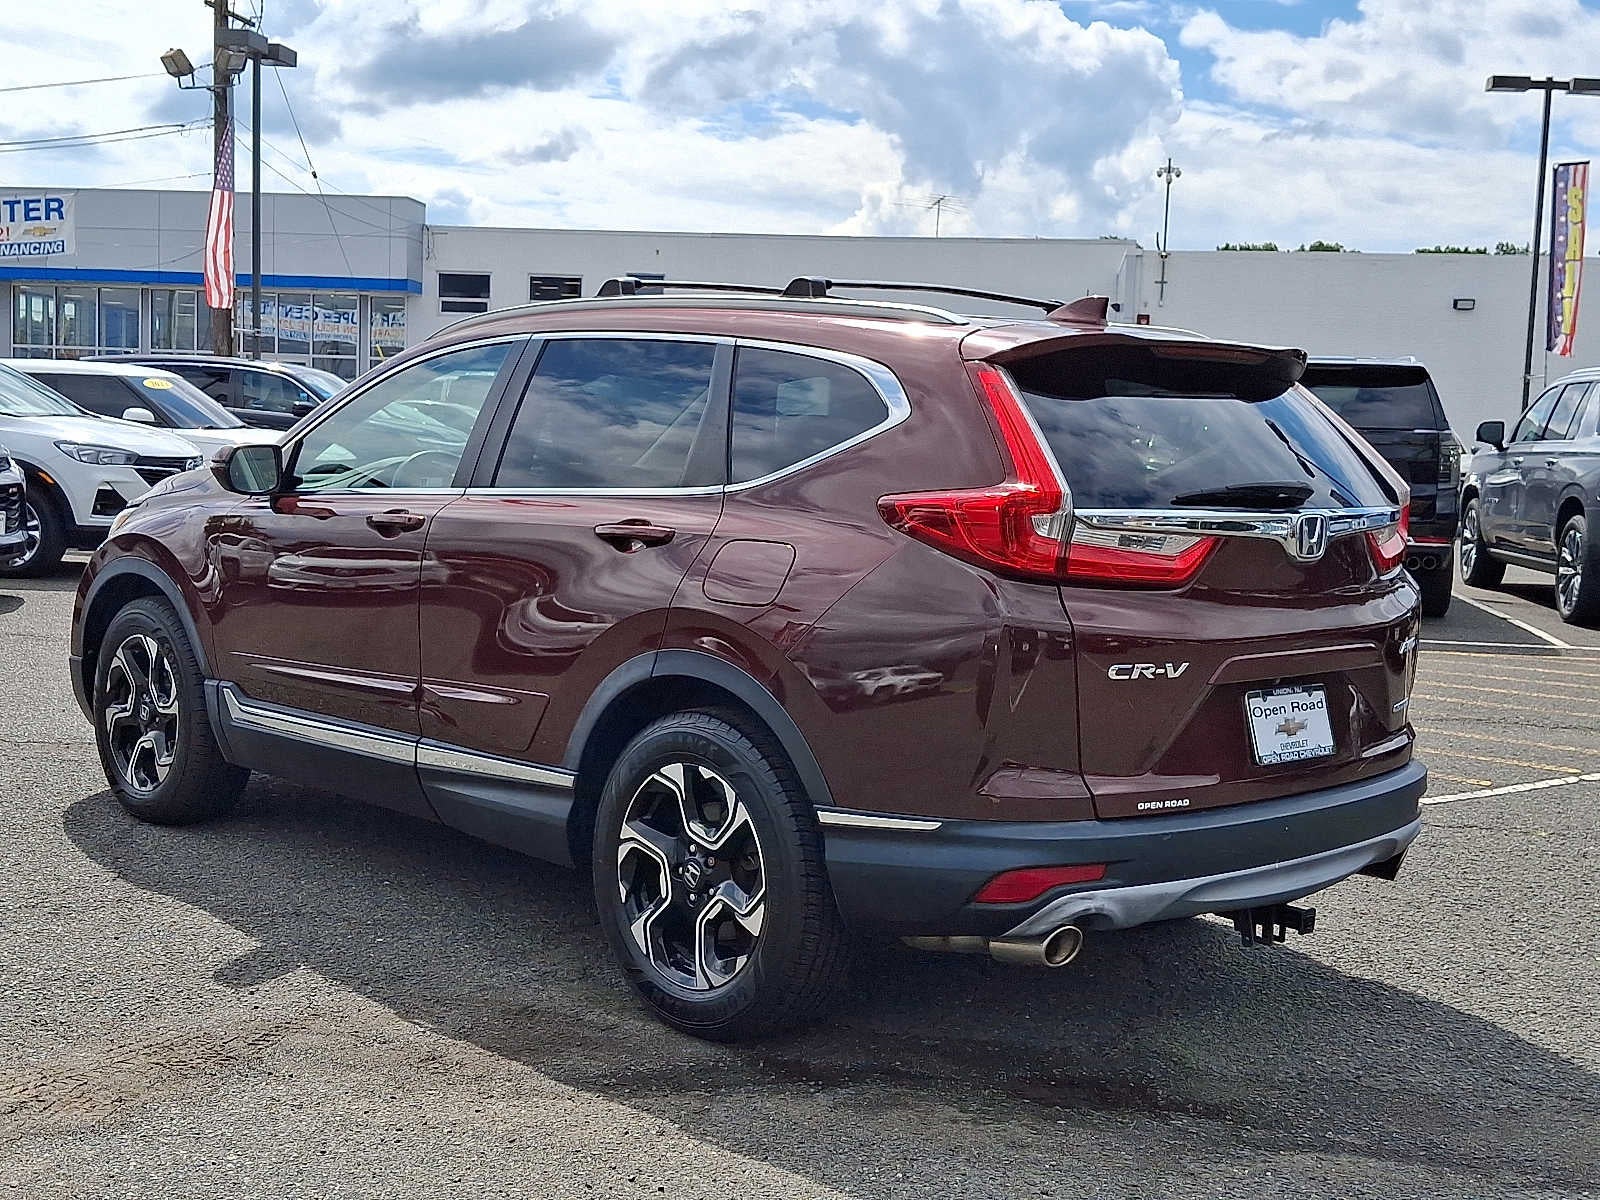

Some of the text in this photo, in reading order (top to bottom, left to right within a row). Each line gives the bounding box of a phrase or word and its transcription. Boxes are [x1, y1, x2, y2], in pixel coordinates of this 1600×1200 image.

[0, 197, 65, 222] TER
[1107, 662, 1190, 680] CR-V
[1252, 698, 1324, 719] Open Road
[1262, 753, 1280, 764] OPEN
[1280, 750, 1299, 762] ROAD
[1137, 799, 1190, 811] OPEN ROAD
